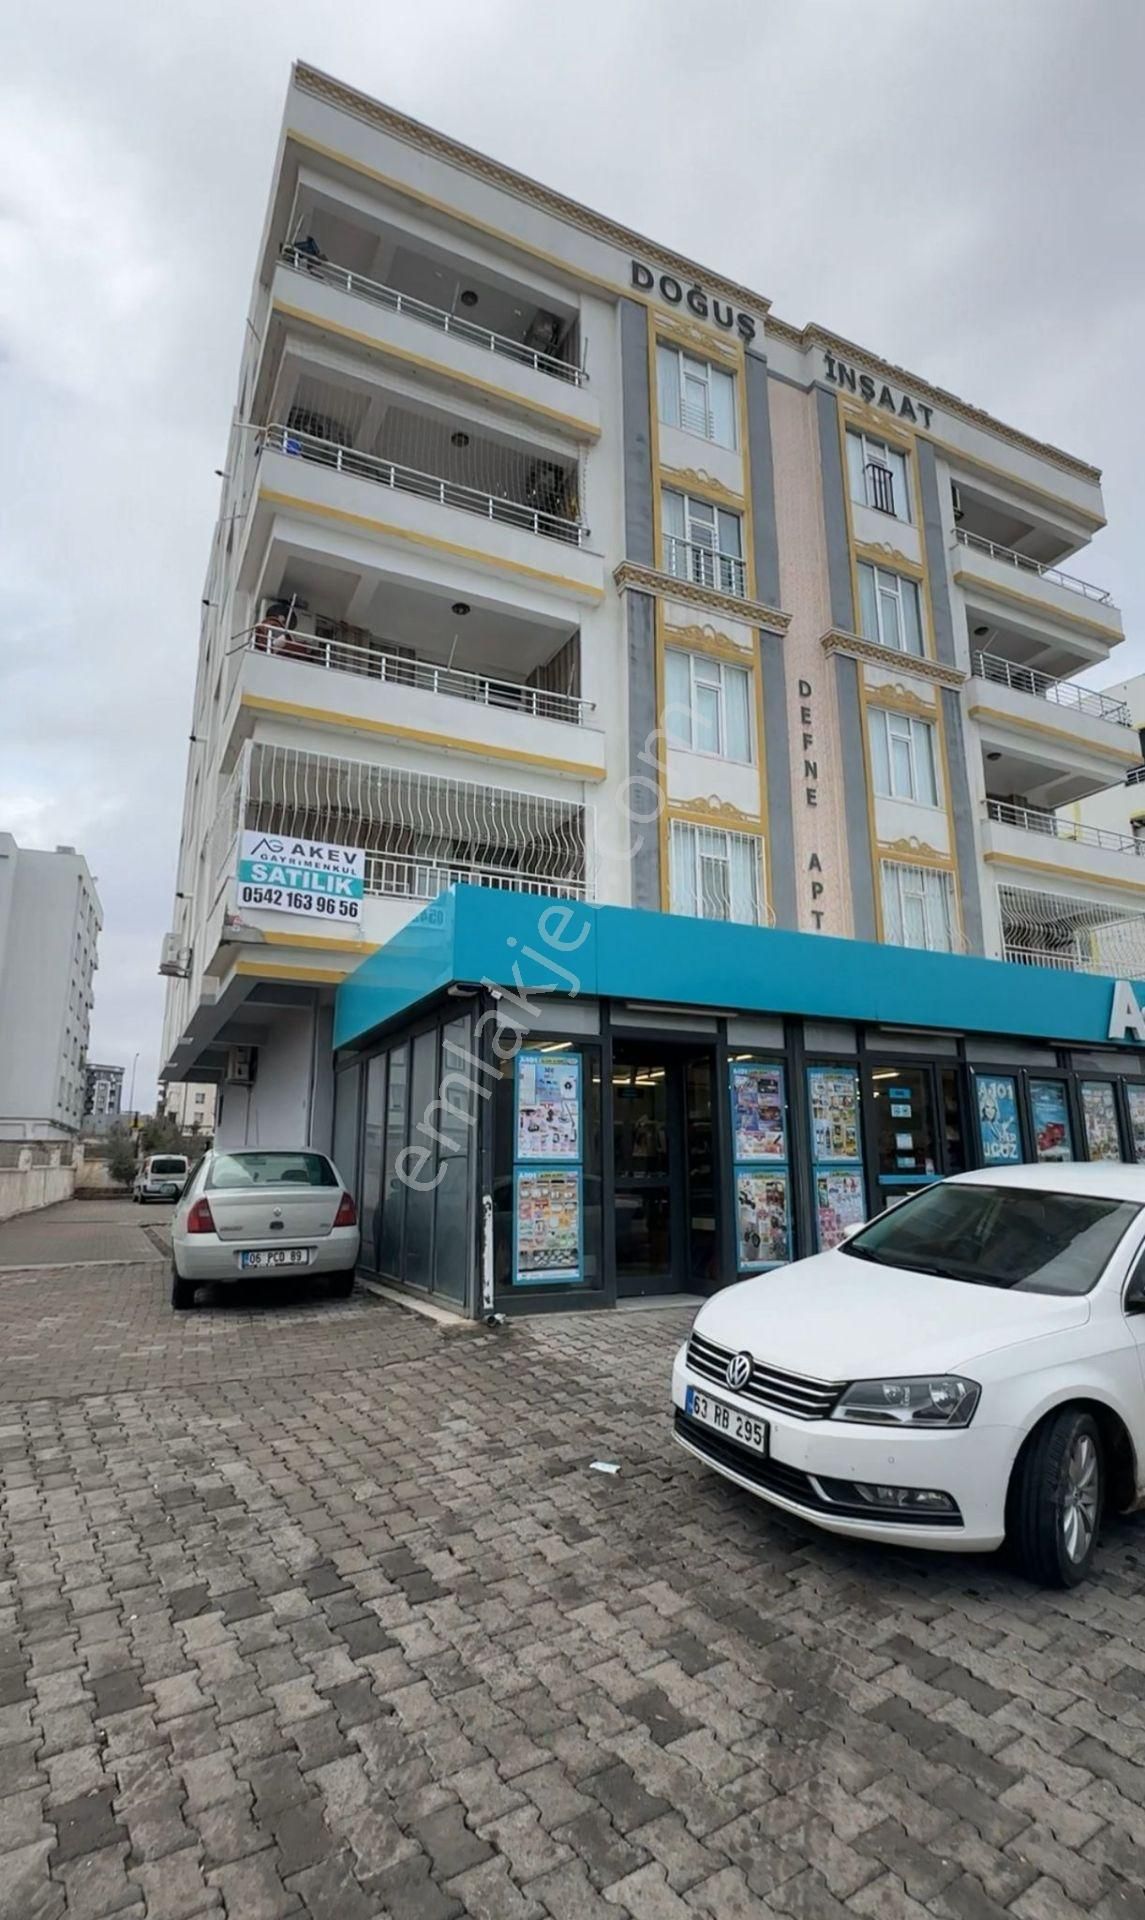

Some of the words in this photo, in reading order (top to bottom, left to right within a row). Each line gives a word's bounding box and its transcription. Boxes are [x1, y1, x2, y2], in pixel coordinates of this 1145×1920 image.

[631, 259, 756, 343] DOĞUŞ
[823, 349, 934, 429] İNŞAAT
[798, 679, 818, 807] DEFNE
[808, 852, 825, 931] APT
[251, 863, 354, 896] SATILIK
[291, 843, 358, 865] AKEV
[242, 886, 282, 905] 0542
[287, 891, 312, 911] 163
[316, 896, 336, 915] 96
[339, 900, 359, 918] 56
[1107, 980, 1145, 1041] A
[249, 1253, 261, 1264] 06
[290, 1250, 302, 1262] 89
[693, 1395, 708, 1419] 63
[714, 1404, 730, 1430] RB
[736, 1416, 762, 1446] 295
